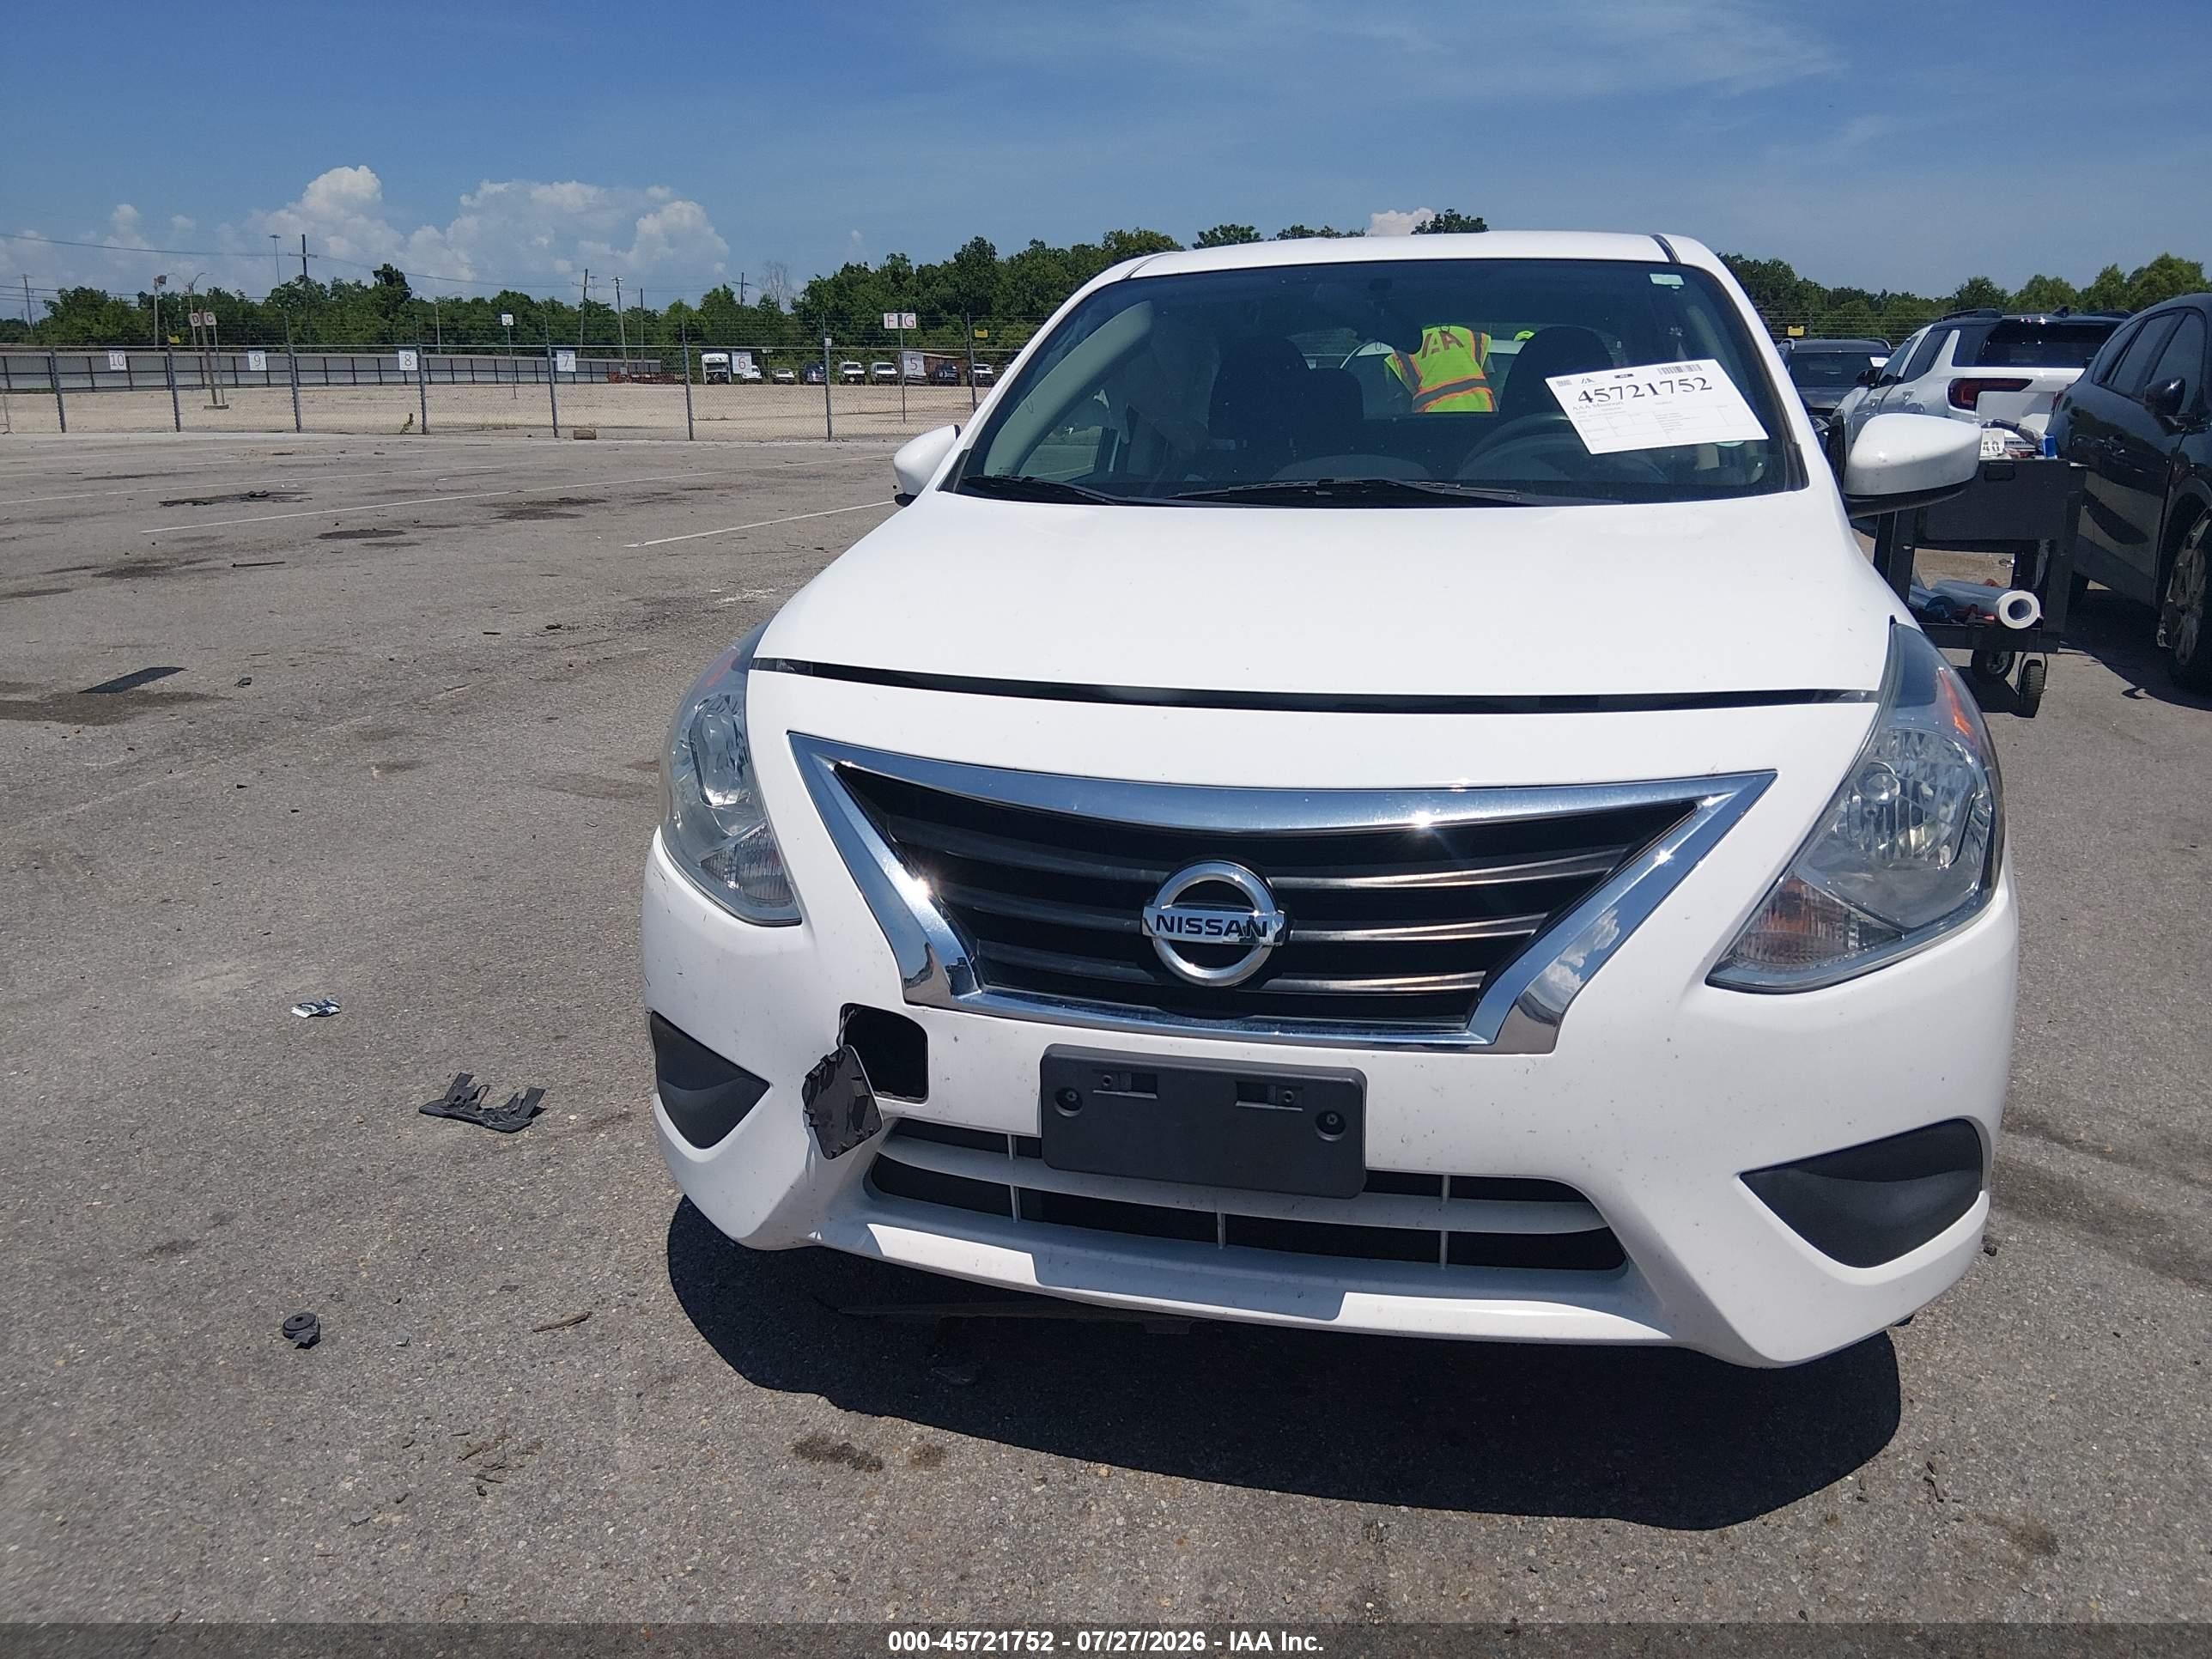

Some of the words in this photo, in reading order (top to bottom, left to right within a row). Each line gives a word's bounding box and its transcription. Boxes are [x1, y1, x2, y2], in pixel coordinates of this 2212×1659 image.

[206, 314, 213, 324] C
[887, 314, 895, 328] F
[904, 314, 915, 328] G
[110, 354, 125, 367] 10
[253, 354, 261, 367] 9
[404, 354, 412, 367] 8
[562, 355, 569, 368] 7
[738, 356, 746, 369] 6
[909, 357, 918, 370] 5
[1577, 377, 1713, 404] 45721752
[1156, 915, 1267, 937] NISSAN
